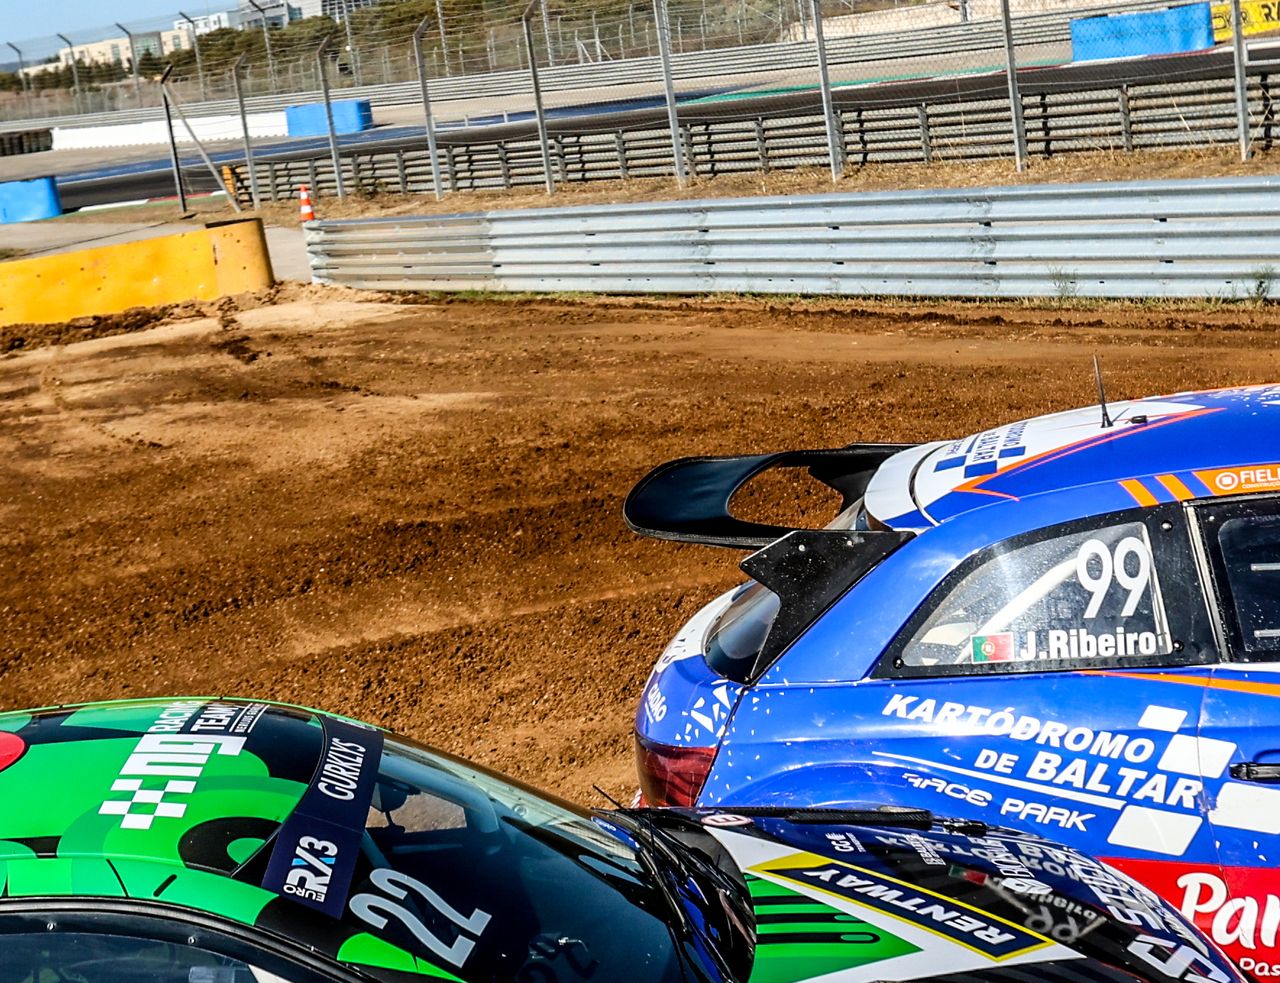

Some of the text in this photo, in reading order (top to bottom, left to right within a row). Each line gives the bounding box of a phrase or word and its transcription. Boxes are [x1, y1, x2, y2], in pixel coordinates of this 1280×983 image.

[1076, 536, 1151, 619] 99
[1019, 627, 1158, 661] J.Ribeiro
[190, 702, 240, 732] TEAM
[881, 693, 1156, 763] KARTÓDROMO
[317, 736, 367, 801] GURKLYS
[974, 748, 1204, 809] DE BALTAR
[902, 772, 1097, 832] RACE PARK
[282, 884, 327, 903] EURO
[286, 835, 339, 894] RX3
[349, 867, 492, 969] 22
[803, 868, 1017, 946] RENTWAY
